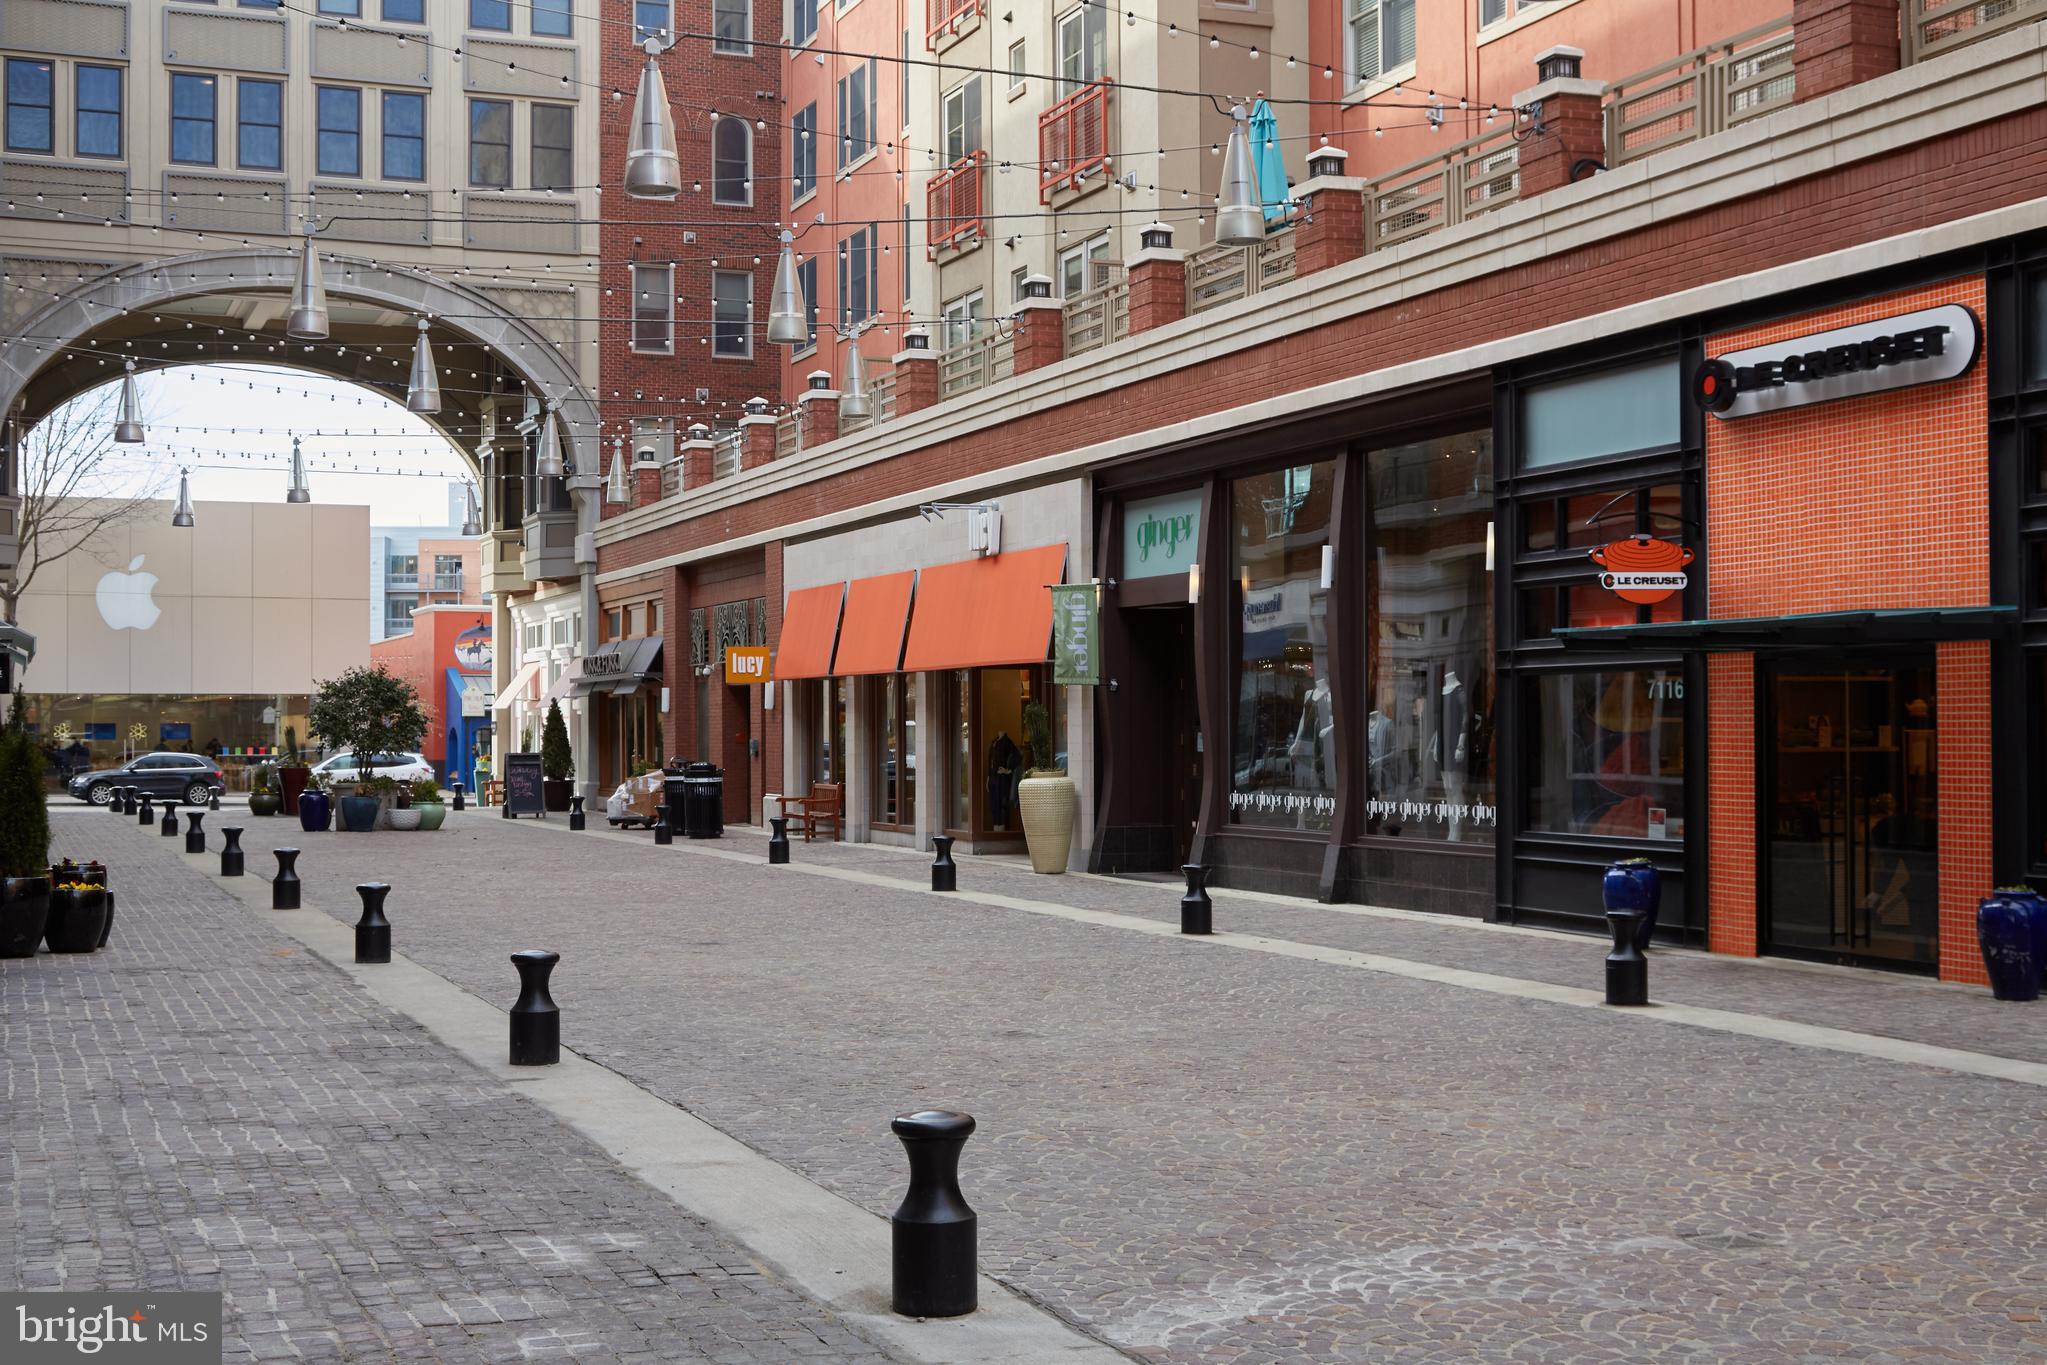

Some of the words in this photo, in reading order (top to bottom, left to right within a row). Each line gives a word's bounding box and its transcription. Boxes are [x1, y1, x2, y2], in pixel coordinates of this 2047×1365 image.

[1736, 361, 1785, 393] LE
[1783, 325, 1950, 383] CREUSET
[1137, 513, 1194, 563] ginger
[1617, 577, 1632, 585] LE
[1633, 576, 1686, 585] CREUSET
[1063, 593, 1088, 673] ginger
[732, 652, 764, 677] lucy
[1647, 679, 1684, 699] 7116
[1229, 789, 1254, 811] ginger
[1256, 791, 1282, 813] ginger
[1284, 792, 1311, 814] ginger
[1366, 797, 1397, 820] ginger
[1399, 798, 1432, 823] ginger
[1434, 800, 1469, 824] ginger
